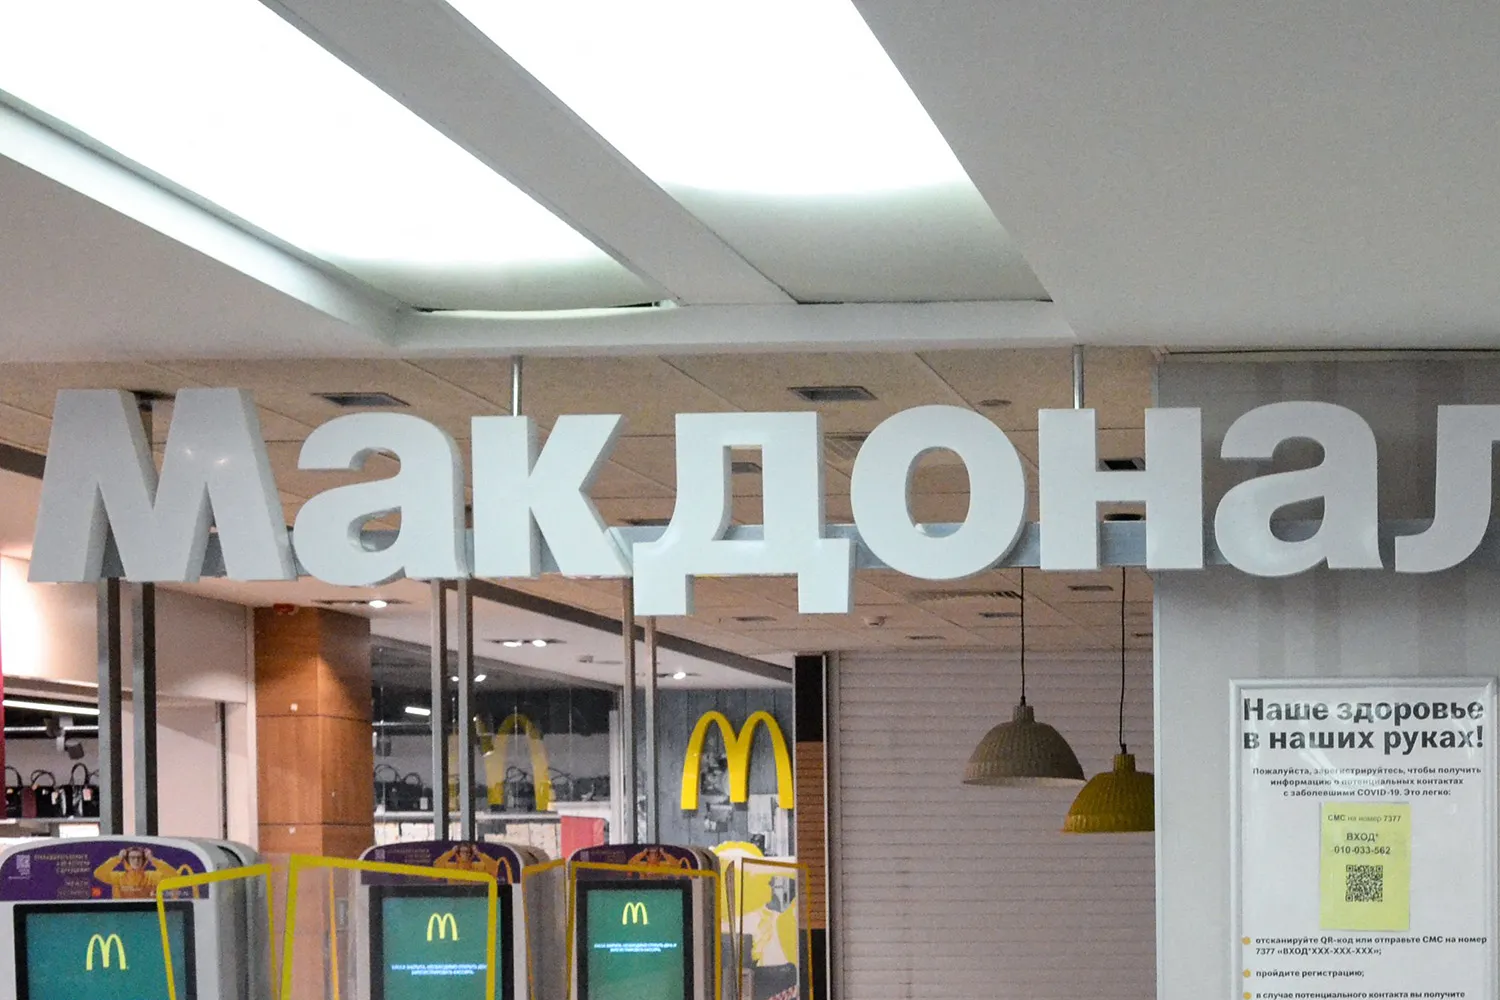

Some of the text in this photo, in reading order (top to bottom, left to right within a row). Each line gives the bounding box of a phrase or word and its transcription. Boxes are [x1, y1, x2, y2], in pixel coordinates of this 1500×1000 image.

[1243, 697, 1485, 726] Наше здоровье
[1243, 724, 1484, 755] в наших руках!
[1252, 766, 1312, 777] Пожалуйста,
[1407, 766, 1436, 776] чтобы
[1437, 767, 1482, 777] получить
[1270, 778, 1332, 788] информацию
[1416, 778, 1464, 786] контактах
[1290, 788, 1356, 797] заболевшими
[1356, 788, 1403, 797] COVID-19.
[1403, 787, 1421, 797] Это
[1422, 788, 1452, 797] легко:
[1327, 813, 1346, 822] СМС
[1383, 814, 1402, 823] 7377
[1333, 845, 1391, 855] 010-033-562
[1255, 935, 1319, 946] отсканируйте
[1374, 936, 1421, 945] отправьте
[1421, 935, 1444, 944] СМС
[1445, 936, 1457, 944] на
[1457, 936, 1488, 946] номер
[1255, 947, 1276, 956] 7377
[1255, 968, 1365, 980] пройдите регистрацию;
[1255, 991, 1466, 1000] в случае потенциального контакта вы получите
